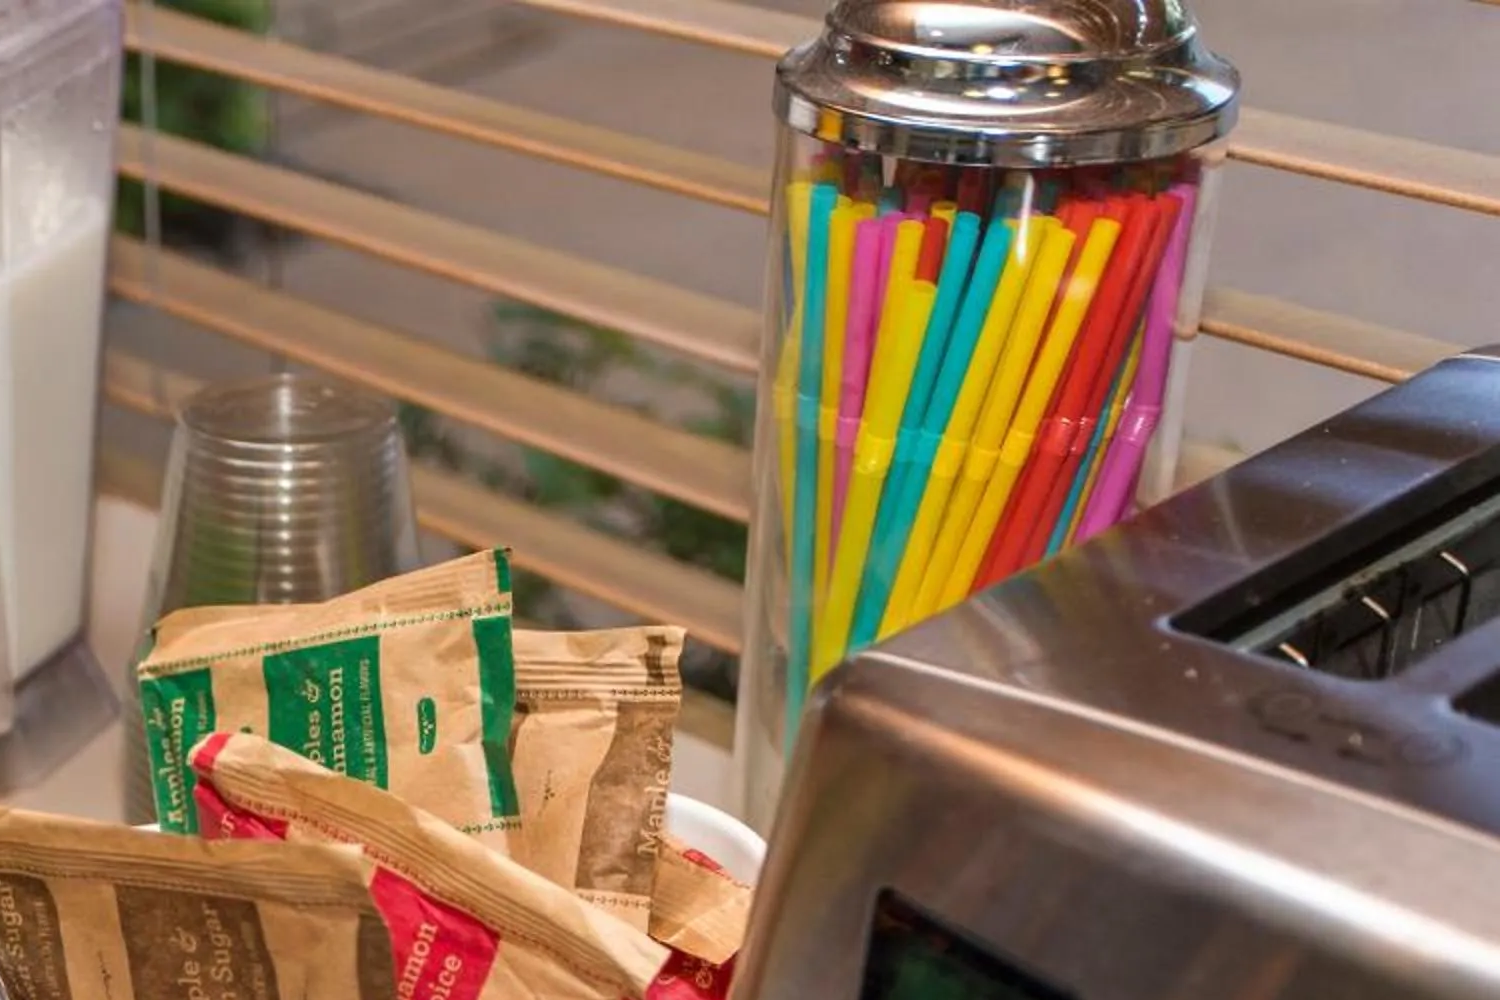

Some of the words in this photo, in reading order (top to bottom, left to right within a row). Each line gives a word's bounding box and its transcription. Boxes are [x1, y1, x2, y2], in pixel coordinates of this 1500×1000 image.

[303, 709, 326, 765] ples
[328, 667, 348, 777] nnamon
[168, 926, 197, 953] &
[200, 899, 234, 984] Sugar
